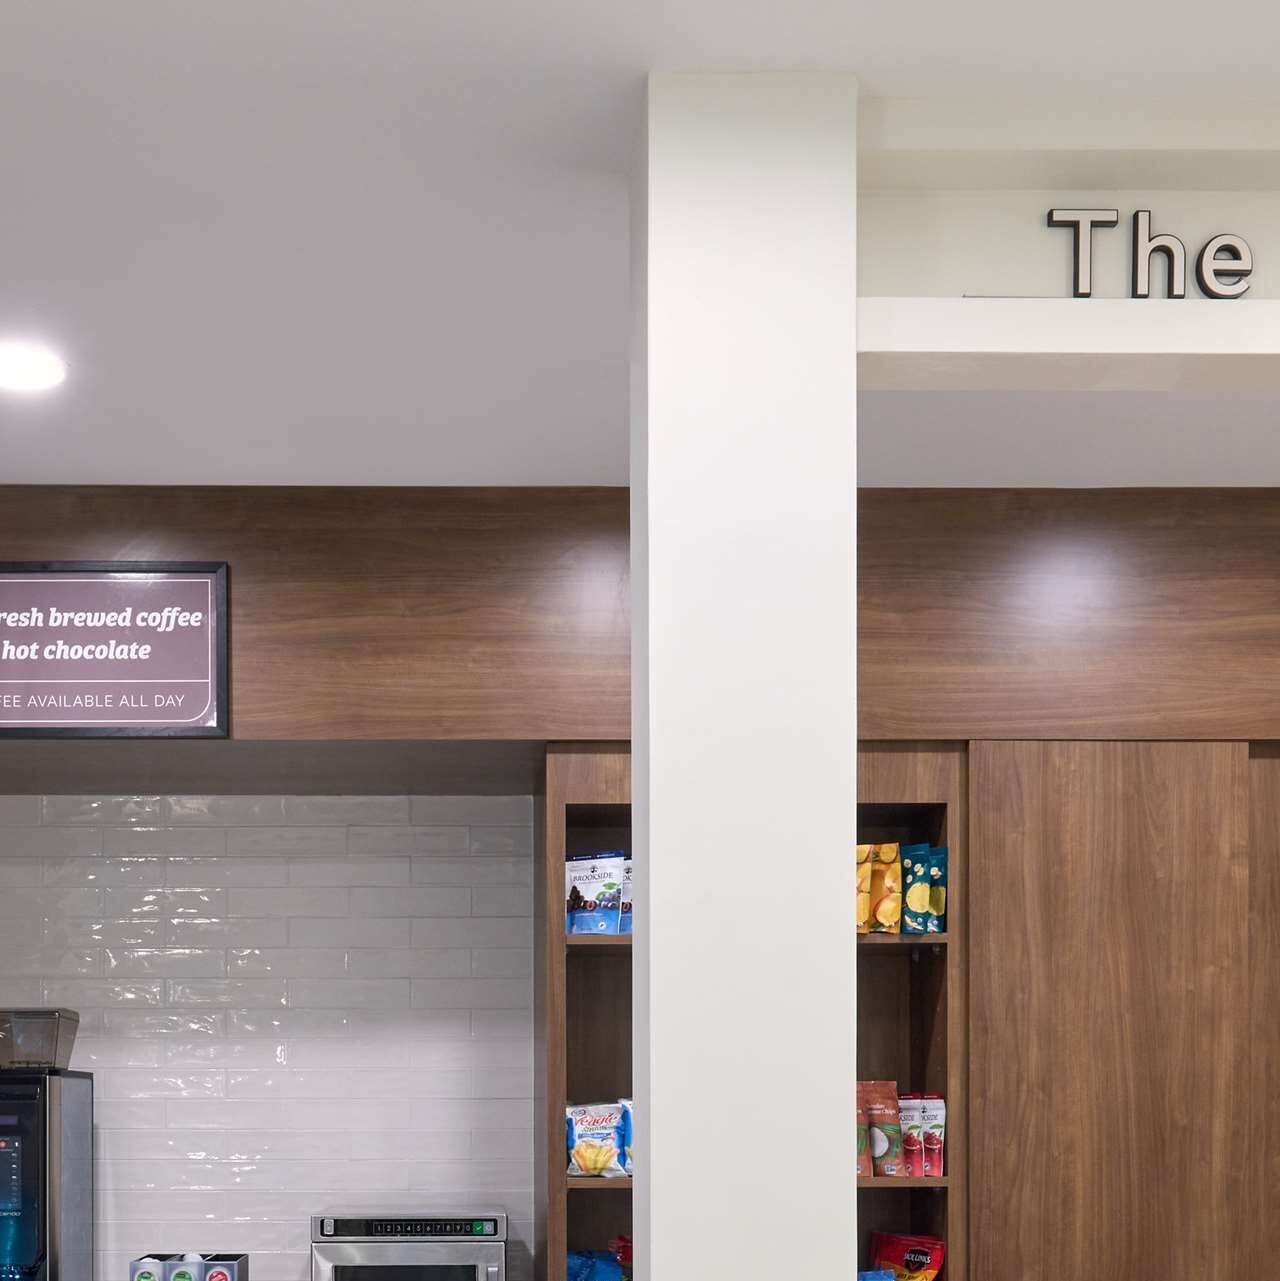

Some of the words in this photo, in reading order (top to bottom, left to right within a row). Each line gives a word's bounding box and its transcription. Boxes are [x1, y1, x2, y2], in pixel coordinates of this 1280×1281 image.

[1047, 208, 1253, 299] The
[49, 607, 132, 627] brewed
[135, 607, 203, 632] coffee
[1, 640, 38, 660] hot
[43, 640, 151, 660] chocolate
[27, 694, 113, 708] AVAILABLE
[119, 694, 148, 708] ALL
[154, 694, 185, 708] DAY
